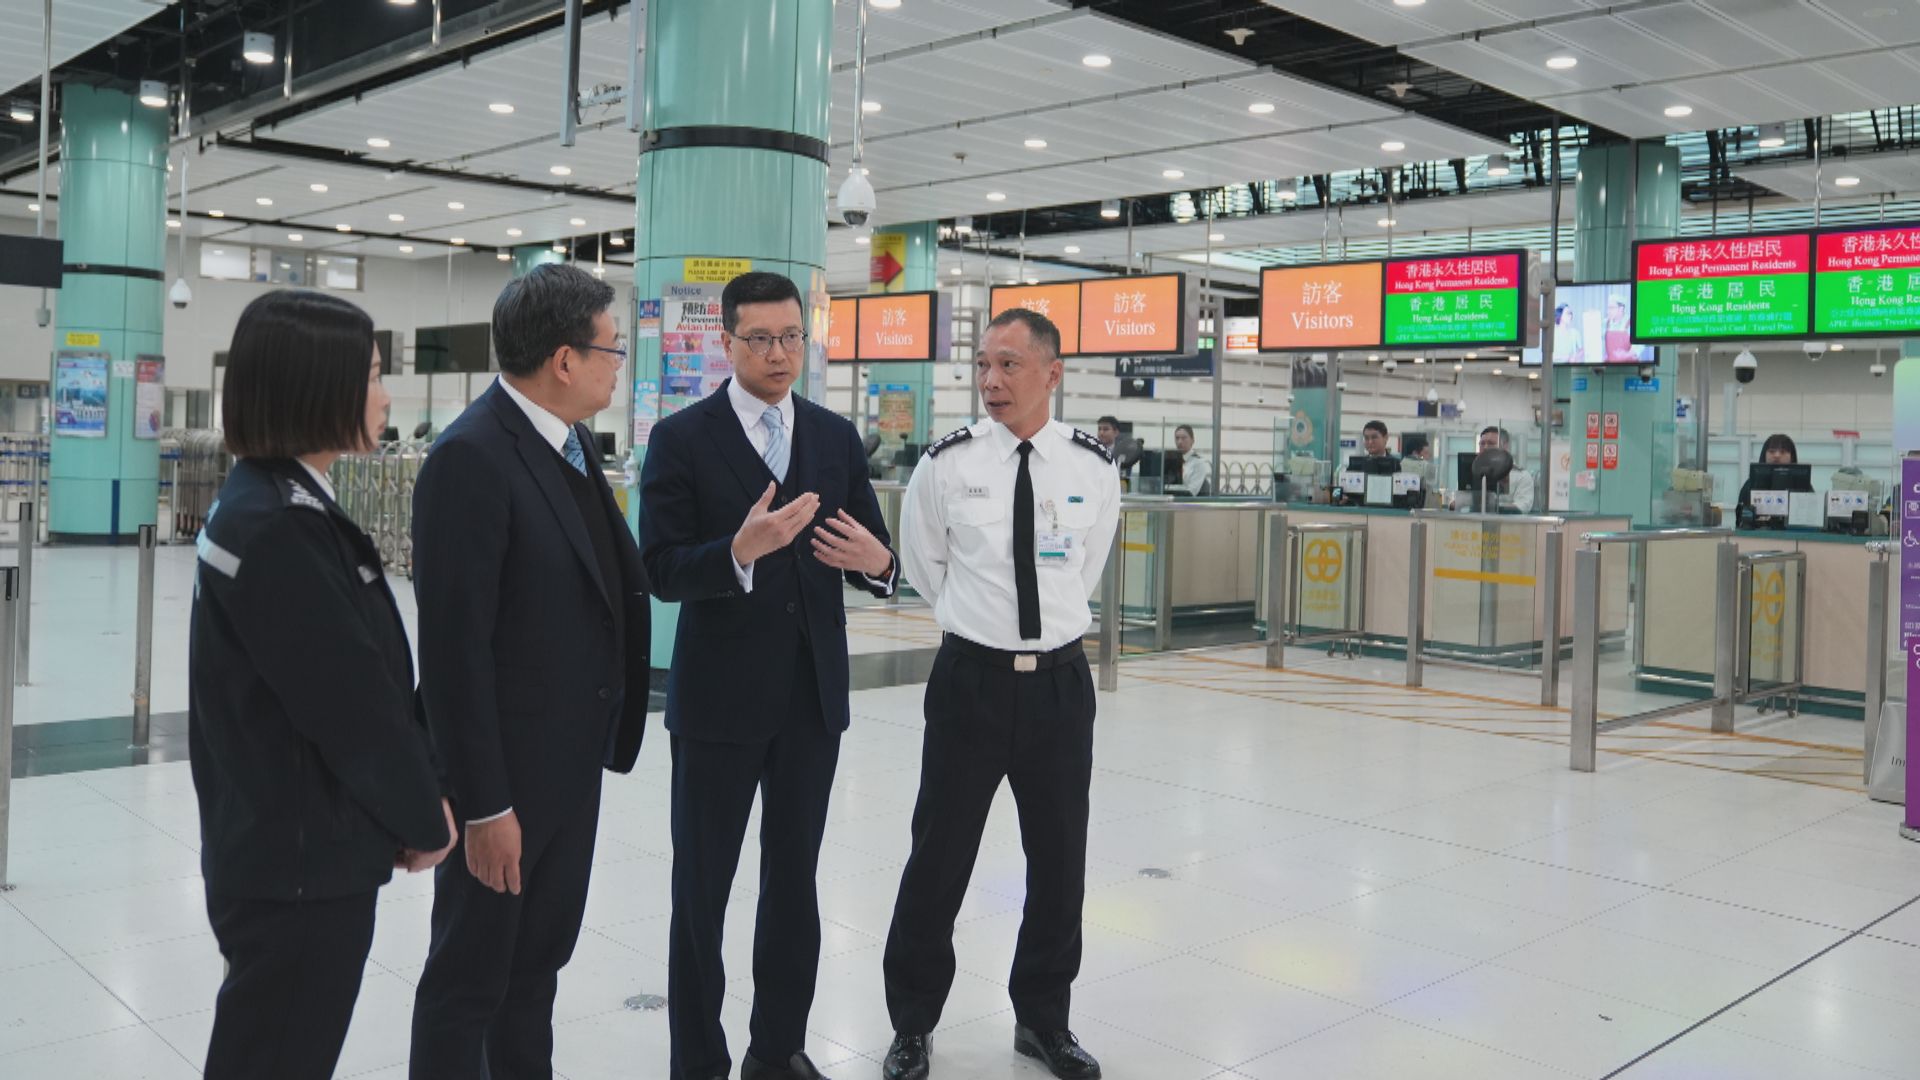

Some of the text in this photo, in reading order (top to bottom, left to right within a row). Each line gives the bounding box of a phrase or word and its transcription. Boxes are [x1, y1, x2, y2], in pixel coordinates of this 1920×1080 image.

[1664, 240, 1782, 263] 香港永久性居民
[1406, 259, 1497, 279] 香港永久性居民
[1649, 260, 1796, 278] Hong Kong Permanent Residents
[1828, 257, 1852, 268] Hong
[1854, 256, 1880, 268] Kong
[671, 286, 702, 296] Notice
[1395, 277, 1508, 291] Hong Kong Permanent Residents
[1302, 280, 1342, 304] 訪客
[1114, 291, 1146, 314] 訪客
[1672, 302, 1770, 314] Hong Kong Residents
[1851, 296, 1876, 307] Hong
[1879, 296, 1904, 305] Kong
[882, 308, 906, 328] 訪客
[1291, 311, 1354, 329] Visitors
[1413, 312, 1488, 323] Hong Kong Residents
[676, 322, 702, 331] Avian
[1104, 320, 1156, 336] Visitors
[876, 332, 913, 346] Visitors
